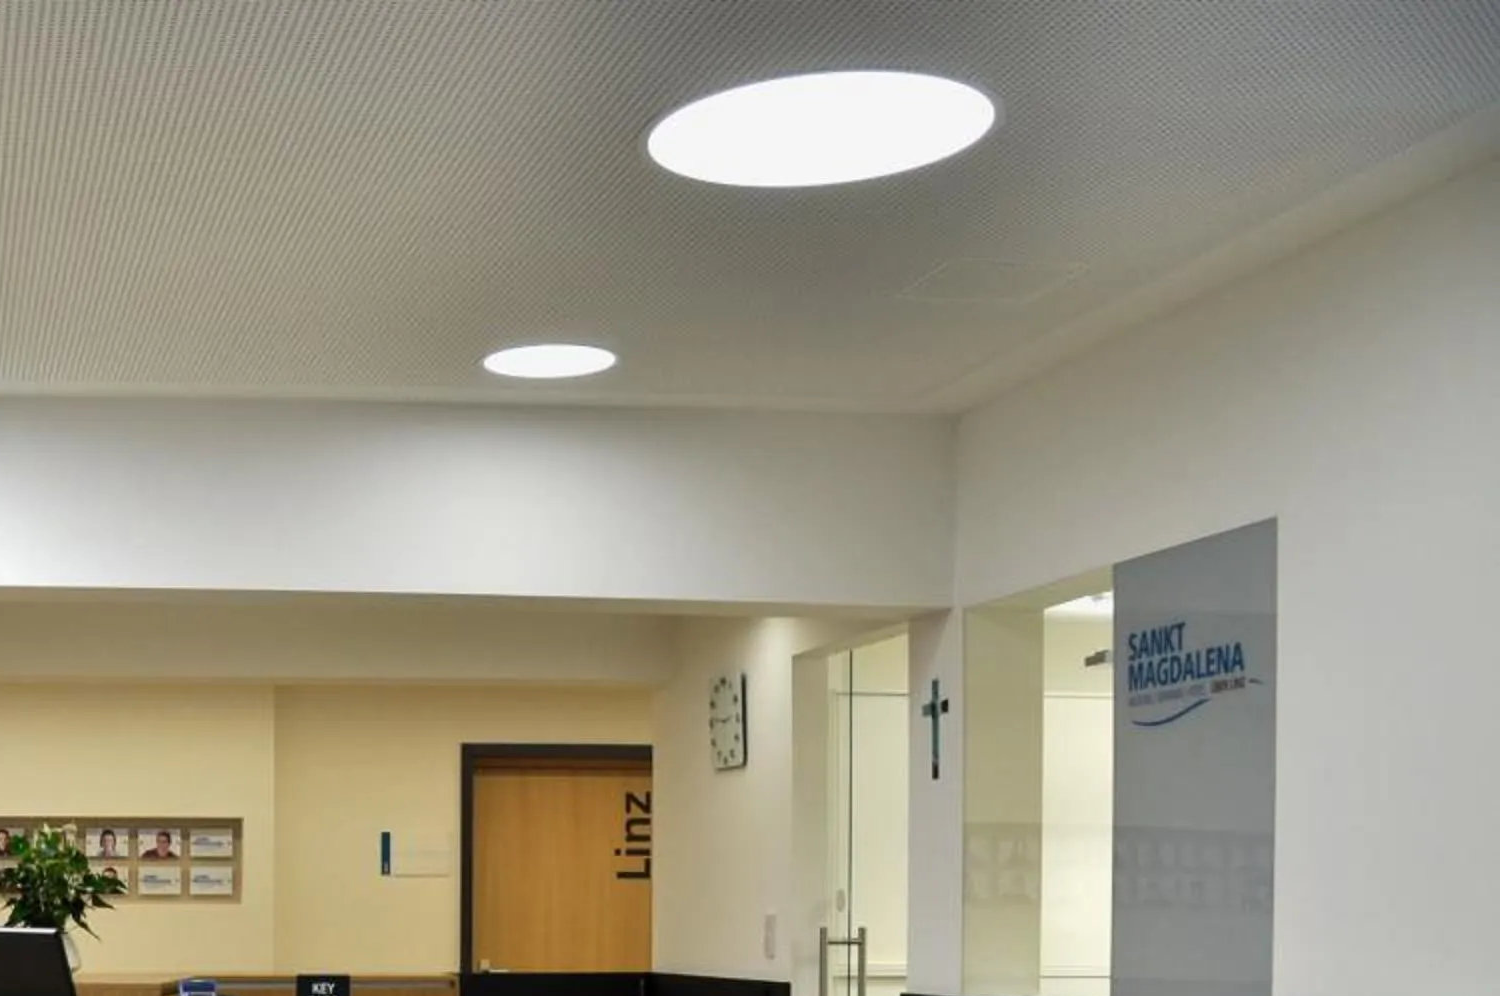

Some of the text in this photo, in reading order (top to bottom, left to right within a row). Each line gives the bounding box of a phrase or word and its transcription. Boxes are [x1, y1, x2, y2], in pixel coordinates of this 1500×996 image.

[1128, 621, 1186, 661] SANKT
[1128, 642, 1245, 692] MAGDALENA
[614, 791, 652, 879] Linz
[312, 983, 335, 994] KEY
